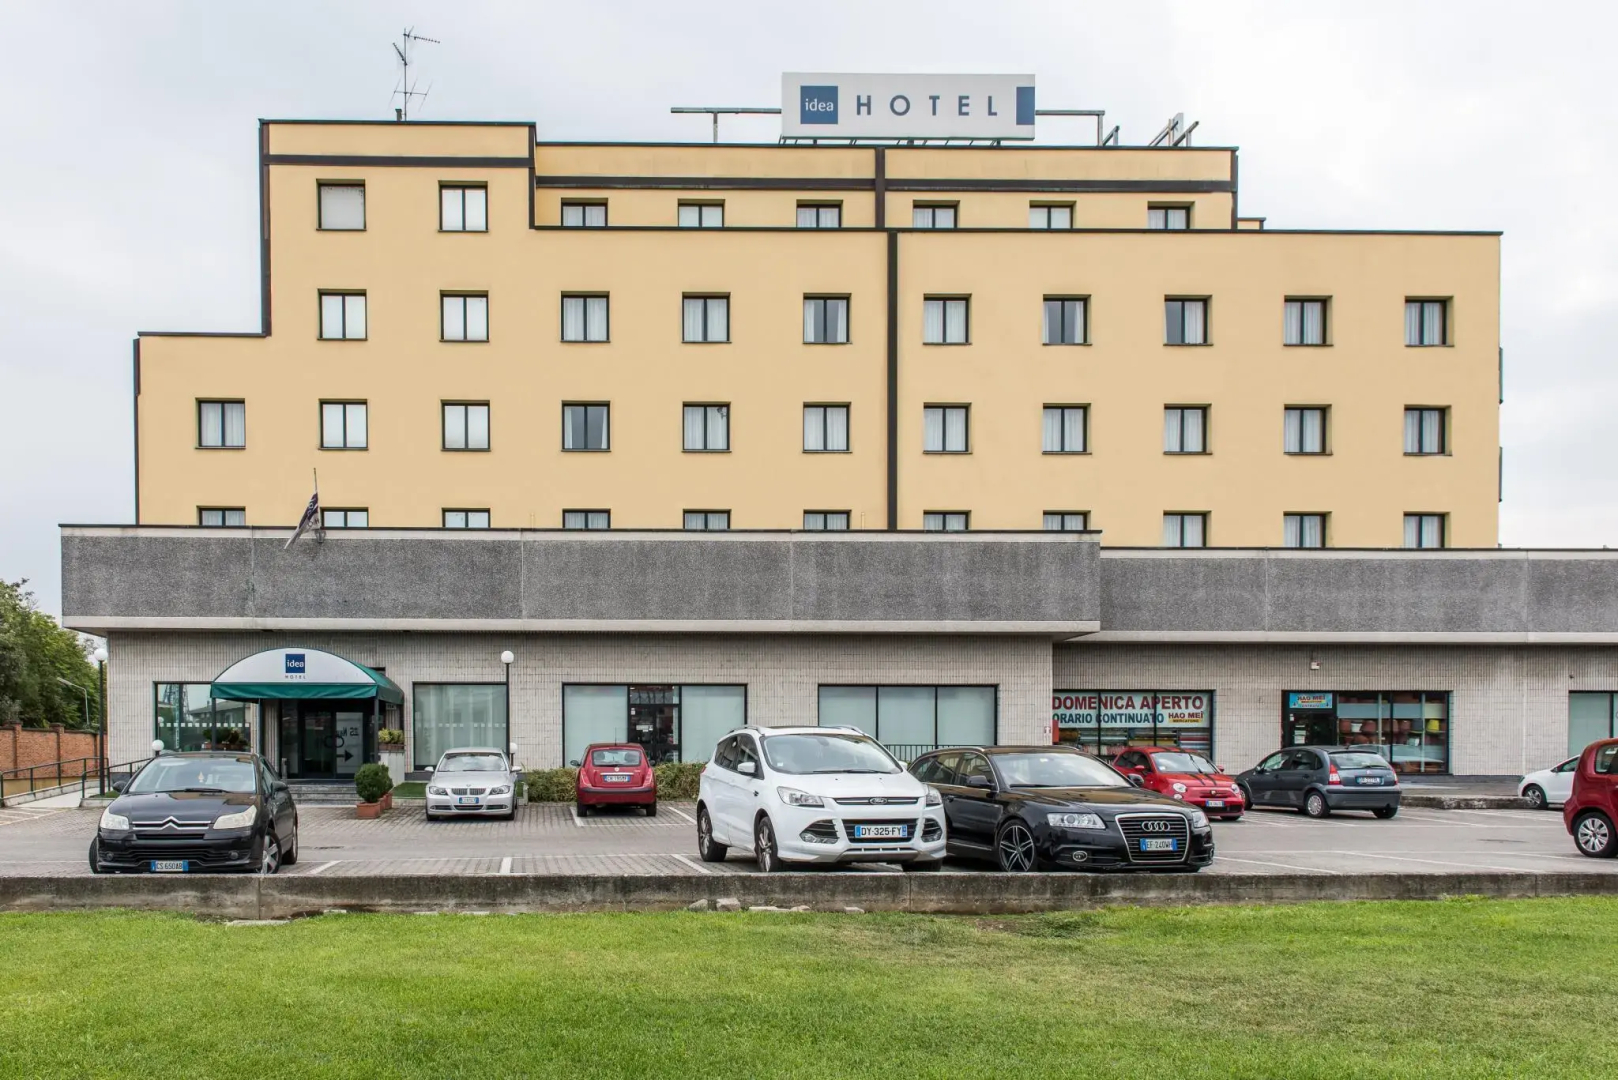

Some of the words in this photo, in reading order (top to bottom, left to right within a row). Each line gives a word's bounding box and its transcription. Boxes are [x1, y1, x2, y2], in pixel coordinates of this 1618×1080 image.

[805, 98, 834, 112] idea
[856, 94, 998, 116] HOTEL
[287, 660, 305, 668] idea
[1052, 695, 1136, 710] DOMENICA
[1139, 695, 1204, 710] APERTO
[1052, 713, 1093, 724] ORARIO
[1096, 713, 1165, 724] CONTINUATO
[861, 827, 902, 836] DY-325-FY
